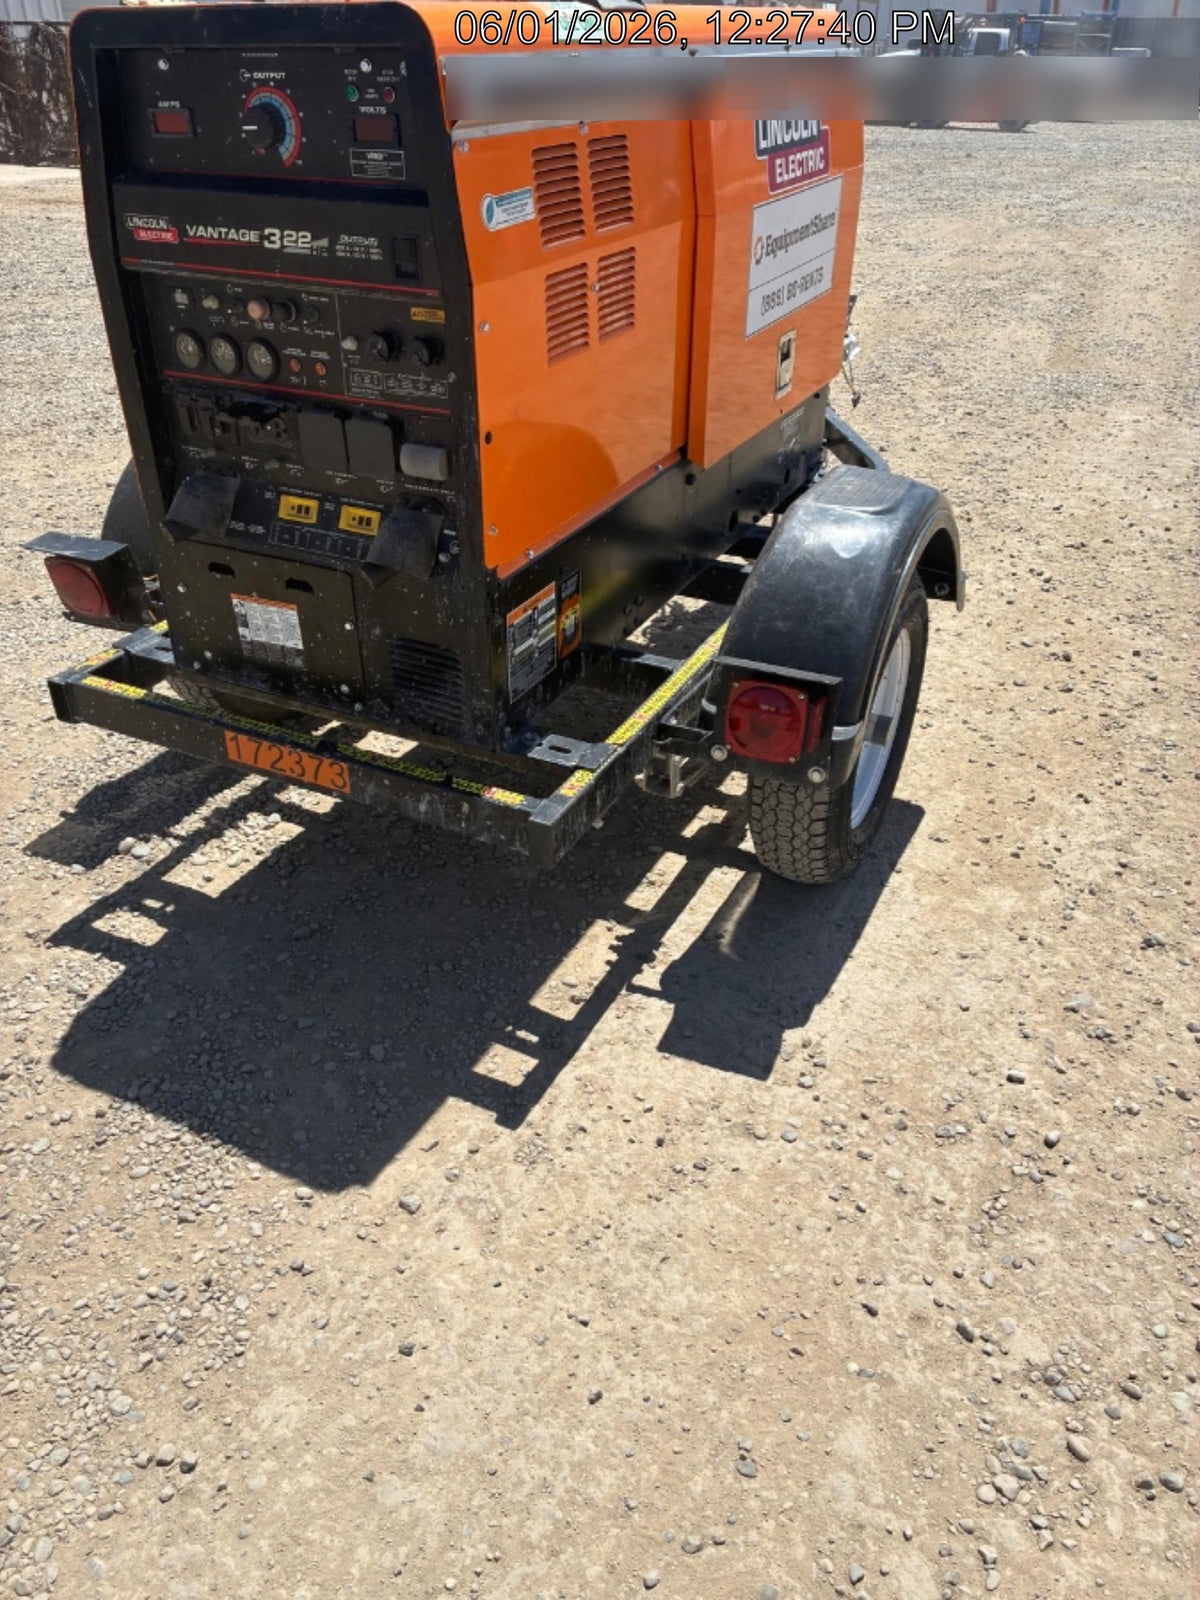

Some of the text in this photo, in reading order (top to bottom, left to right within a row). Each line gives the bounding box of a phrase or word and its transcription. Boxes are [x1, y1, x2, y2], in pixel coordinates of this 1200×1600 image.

[774, 146, 825, 184] ELECTRIC
[127, 216, 168, 230] LINCOLN
[186, 224, 312, 249] VANTAGE 322
[764, 211, 837, 258] EquipmentShare
[229, 734, 347, 790] 172373
